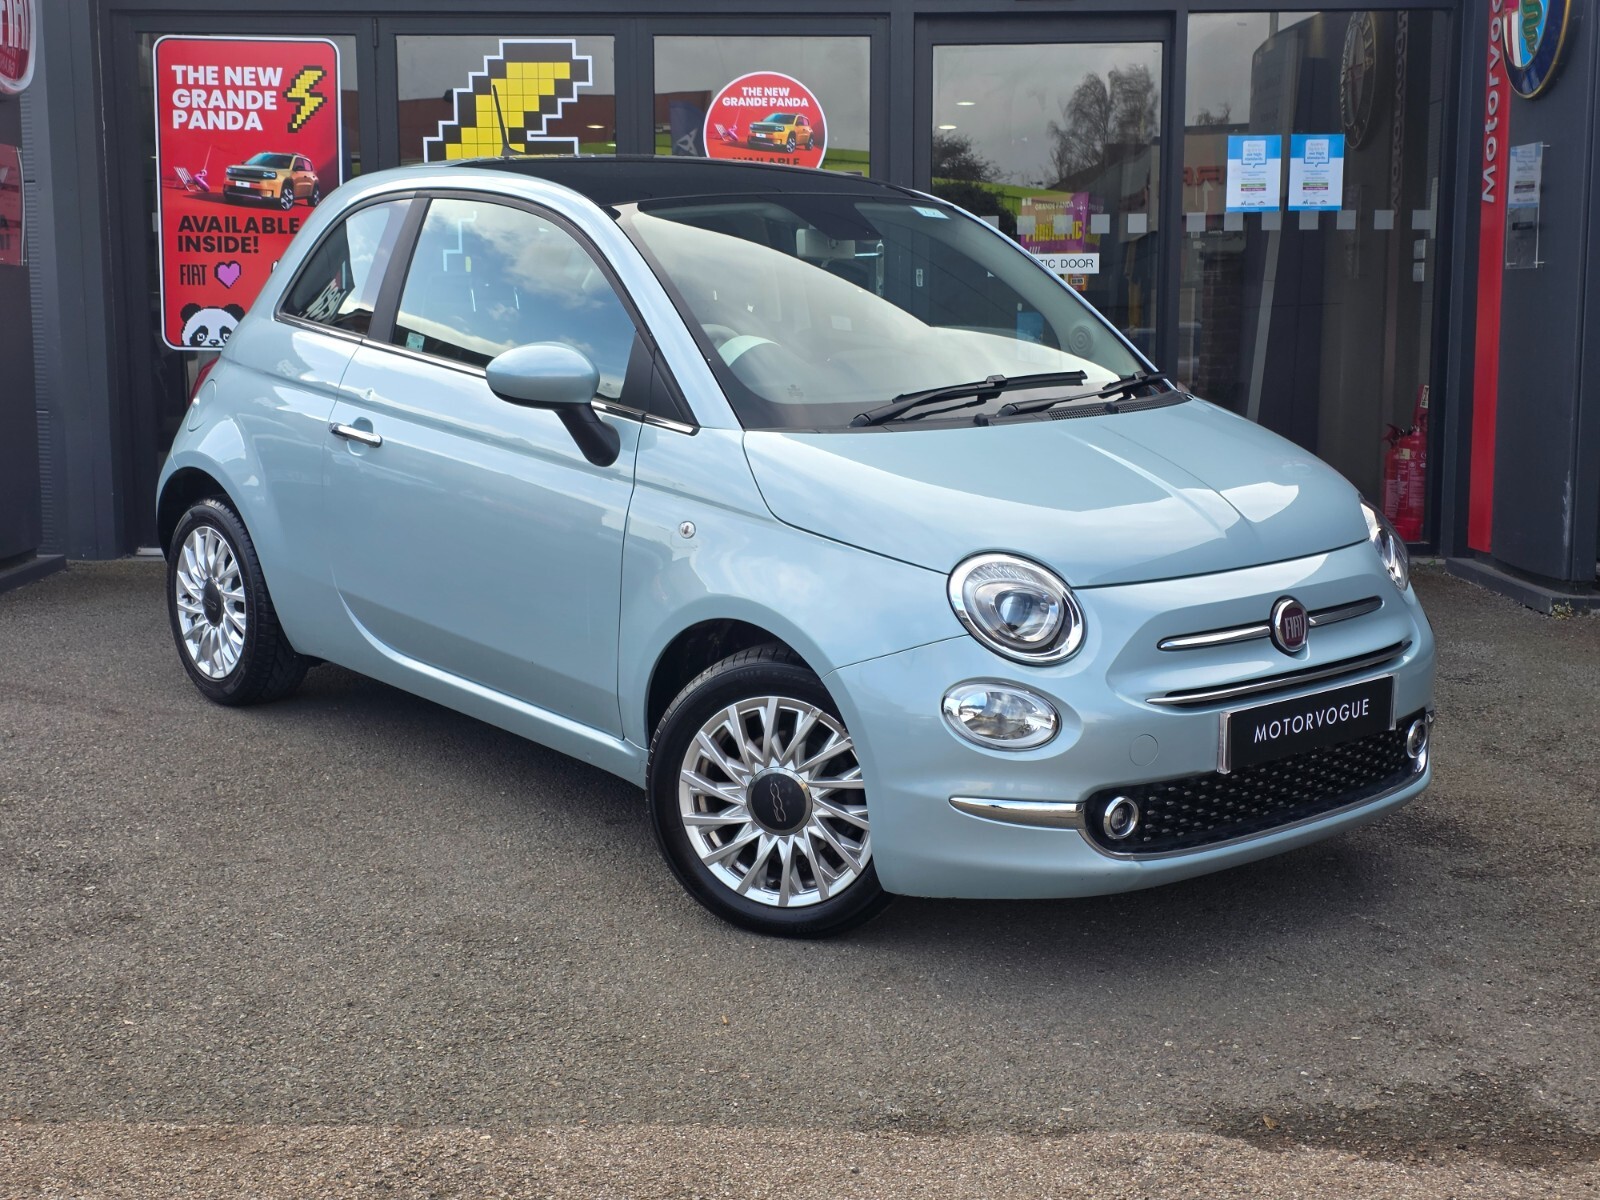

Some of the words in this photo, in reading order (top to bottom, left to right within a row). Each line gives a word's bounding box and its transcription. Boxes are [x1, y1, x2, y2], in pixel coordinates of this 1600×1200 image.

[171, 65, 219, 85] THE
[224, 66, 283, 87] NEW
[172, 88, 278, 110] GRANDE
[722, 97, 768, 107] GRANDE
[769, 98, 809, 107] PANDA
[741, 87, 762, 97] THE
[764, 87, 790, 97] NEW
[172, 109, 263, 131] PANDA
[178, 215, 300, 234] AVAILABLE
[178, 235, 259, 254] INSIDE!
[1060, 258, 1094, 269] DOOR
[180, 264, 207, 286] FIAT
[1285, 614, 1303, 640] FIAT
[1254, 698, 1370, 744] MOTORVOGUE
